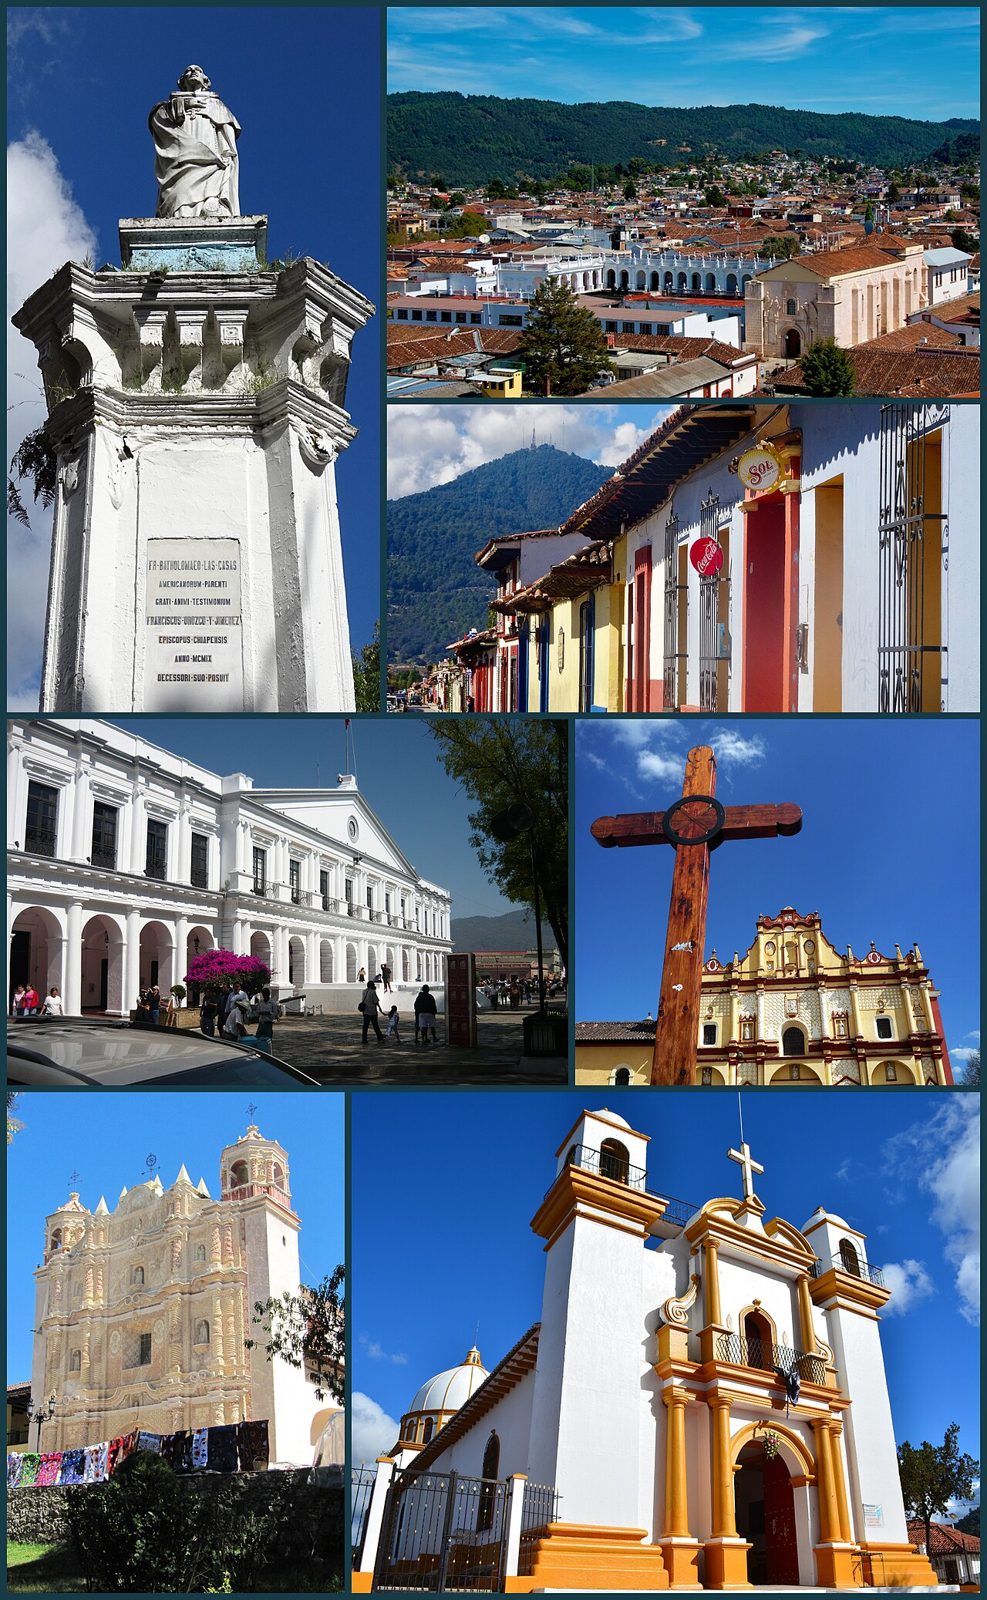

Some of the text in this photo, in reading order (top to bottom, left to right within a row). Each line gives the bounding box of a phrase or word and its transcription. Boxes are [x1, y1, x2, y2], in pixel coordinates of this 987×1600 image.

[217, 560, 237, 571] CASAS
[158, 635, 191, 644] EPISCOPUS
[157, 673, 191, 682] DECESSORI
[207, 673, 229, 682] POSUIT
